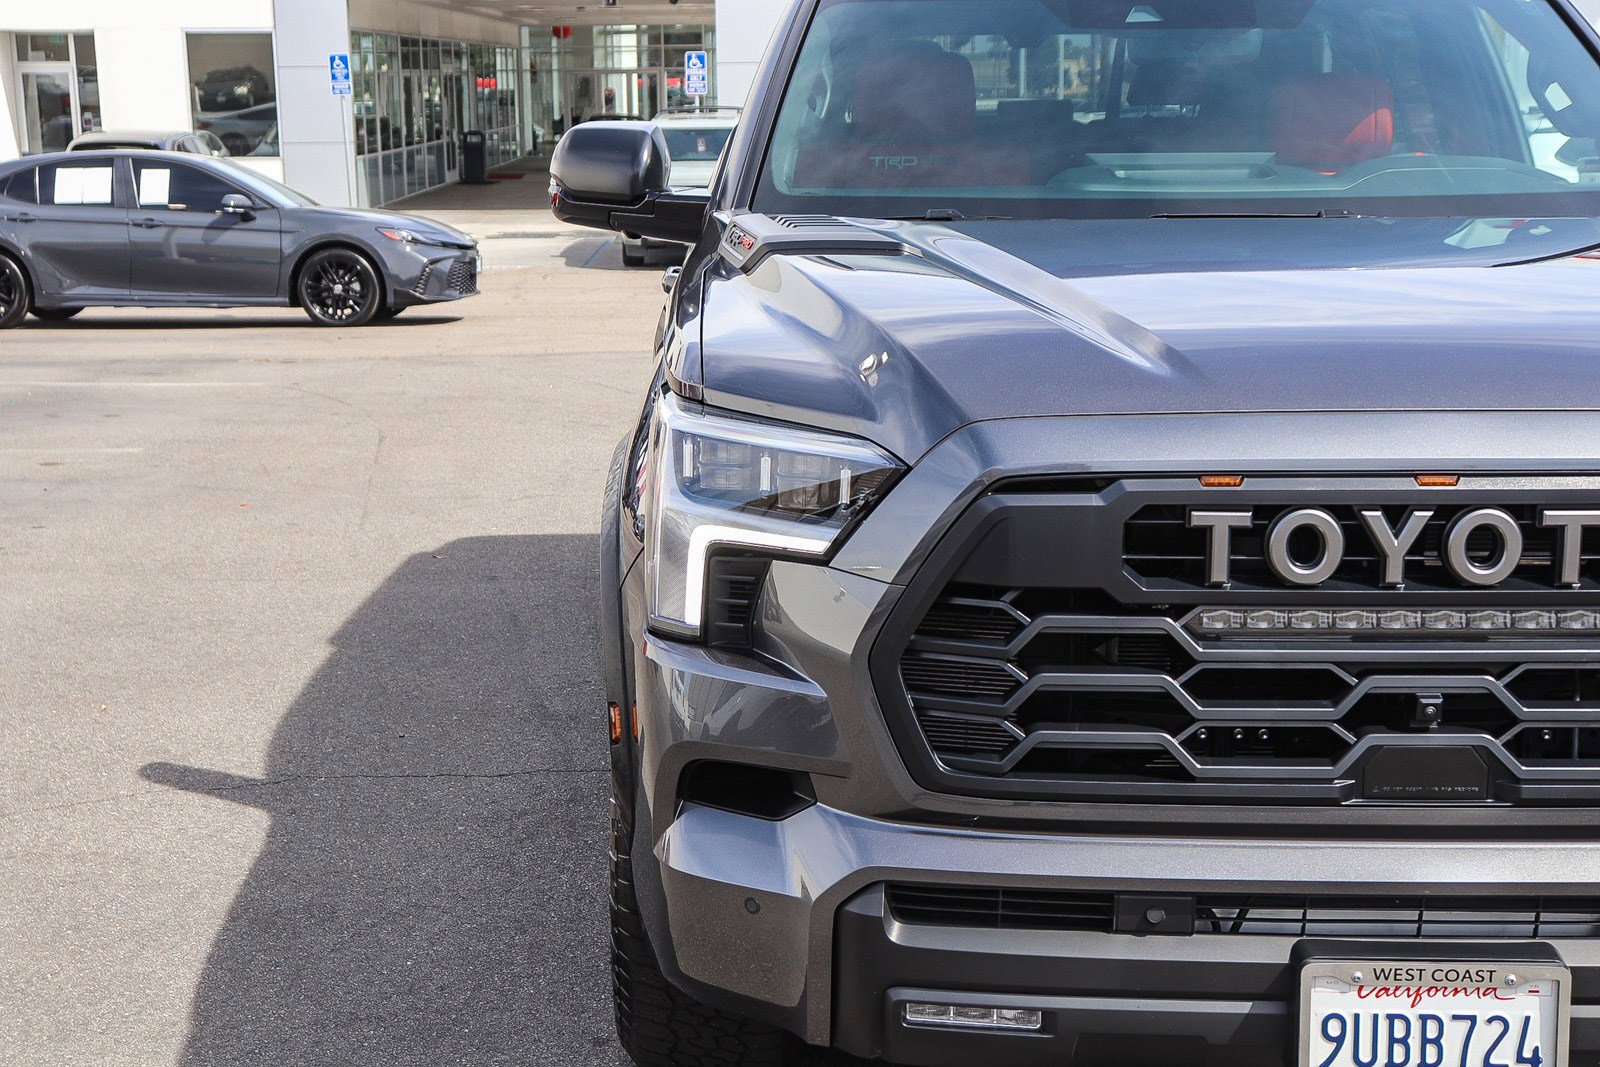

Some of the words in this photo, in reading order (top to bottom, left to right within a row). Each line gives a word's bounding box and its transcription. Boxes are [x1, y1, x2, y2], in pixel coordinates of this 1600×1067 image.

[869, 156, 918, 169] TRD
[1373, 967, 1426, 983] WEST
[1431, 969, 1497, 983] COAST
[1319, 1012, 1543, 1067] 9UBB724
